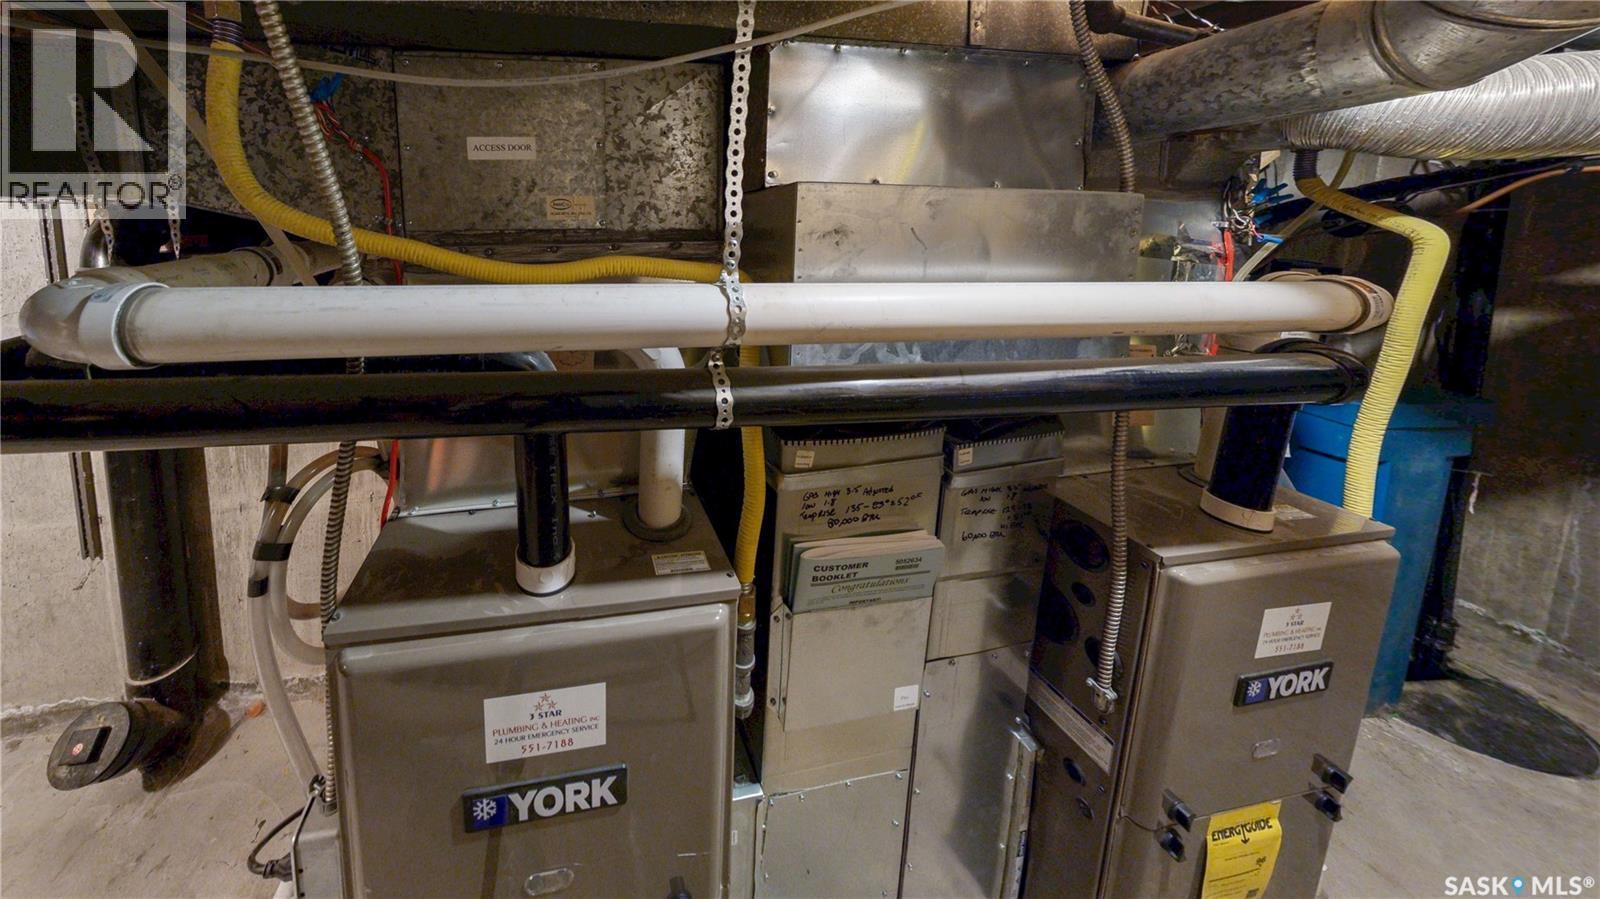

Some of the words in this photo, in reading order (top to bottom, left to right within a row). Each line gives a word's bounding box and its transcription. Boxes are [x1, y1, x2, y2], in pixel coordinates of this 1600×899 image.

[473, 144, 505, 152] ACCESS
[507, 144, 532, 152] DOOR
[813, 561, 869, 573] CUSTOMER
[811, 571, 858, 583] BOOKLET
[831, 577, 910, 594] Congratulations
[1268, 667, 1330, 700] YORK
[529, 713, 535, 721] 3
[538, 709, 562, 720] STAR
[492, 723, 539, 737] PLUMBING
[541, 721, 548, 729] &
[550, 715, 588, 728] HEATING
[494, 738, 503, 746] 24
[505, 735, 526, 744] HOUR
[528, 729, 570, 741] EMERGENCY
[572, 723, 599, 734] SERVICE
[521, 738, 574, 754] 551-7188
[508, 775, 618, 822] YORK
